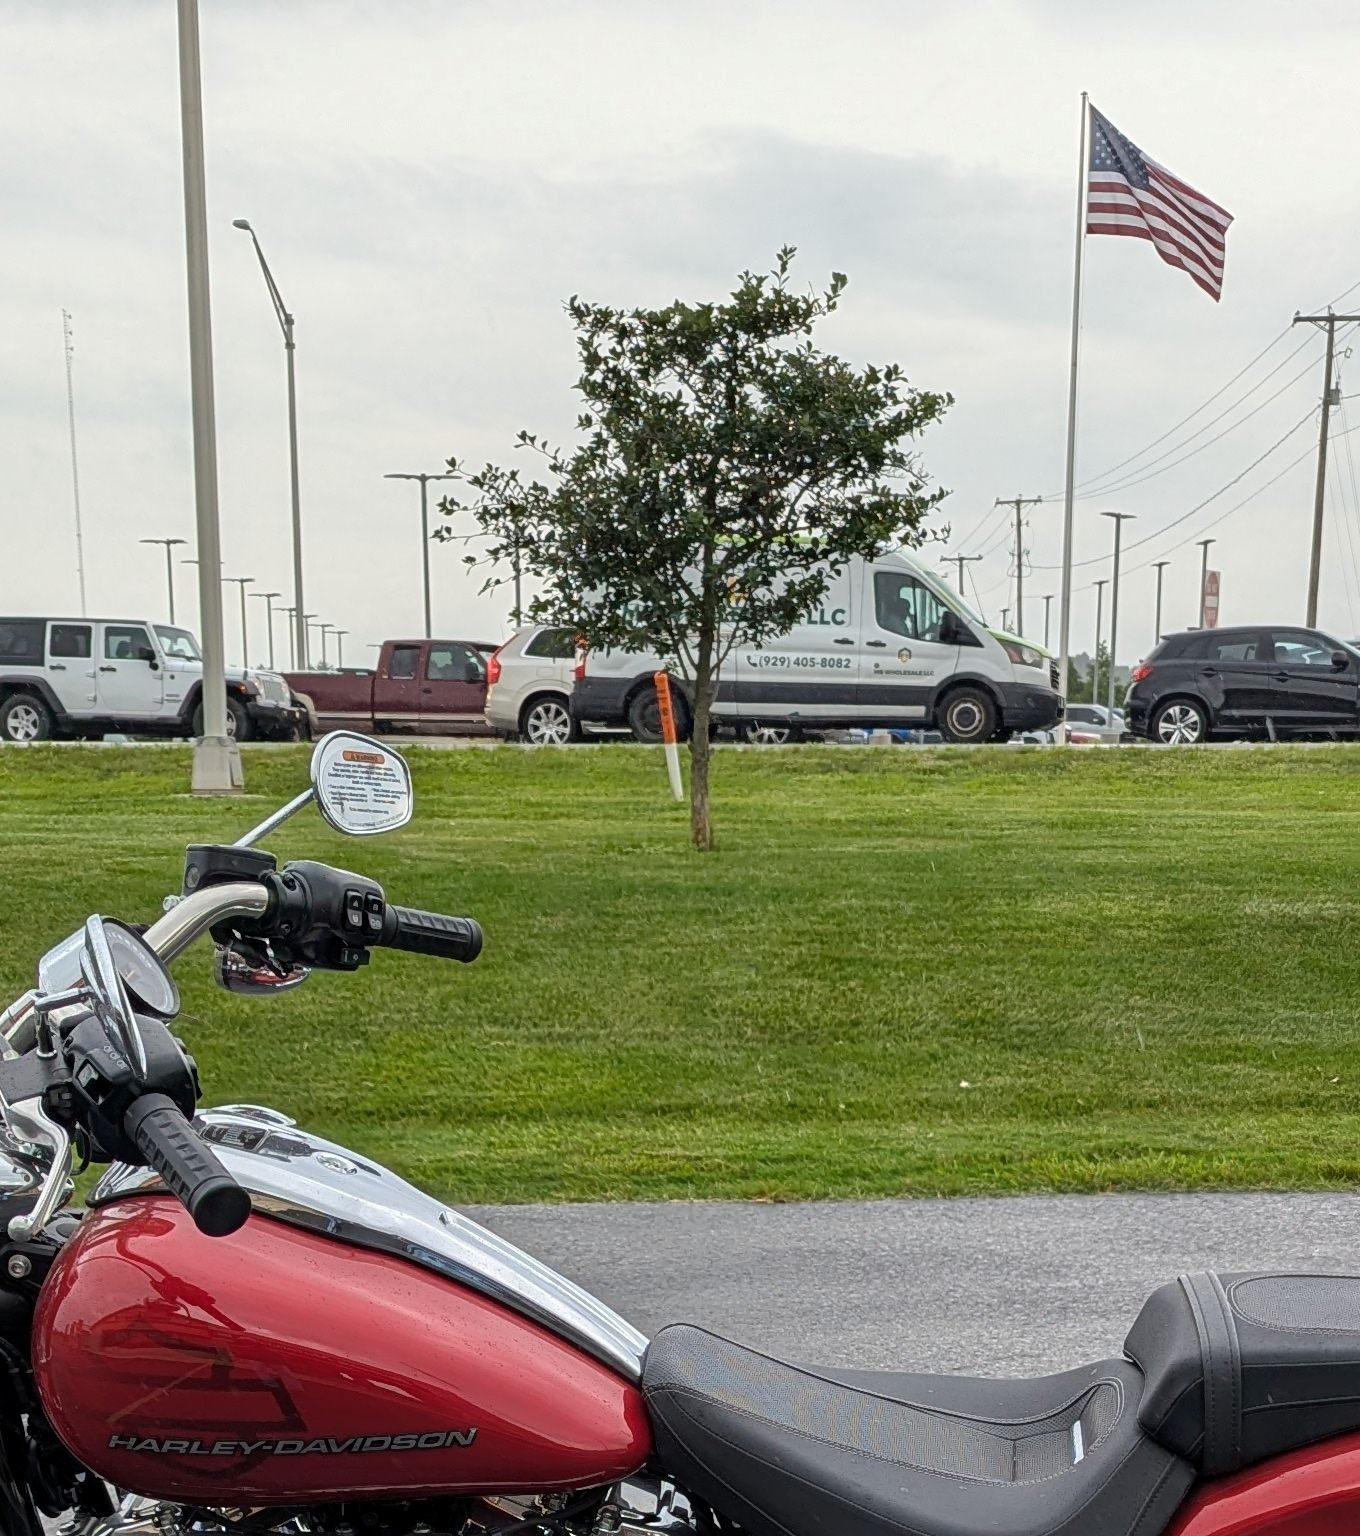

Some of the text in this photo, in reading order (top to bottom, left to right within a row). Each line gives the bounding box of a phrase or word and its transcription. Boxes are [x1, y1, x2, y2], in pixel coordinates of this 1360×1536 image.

[807, 608, 846, 626] LLC
[758, 656, 851, 668] (929) 405-8082
[108, 1428, 478, 1455] HARLEY-DAVIDSON
